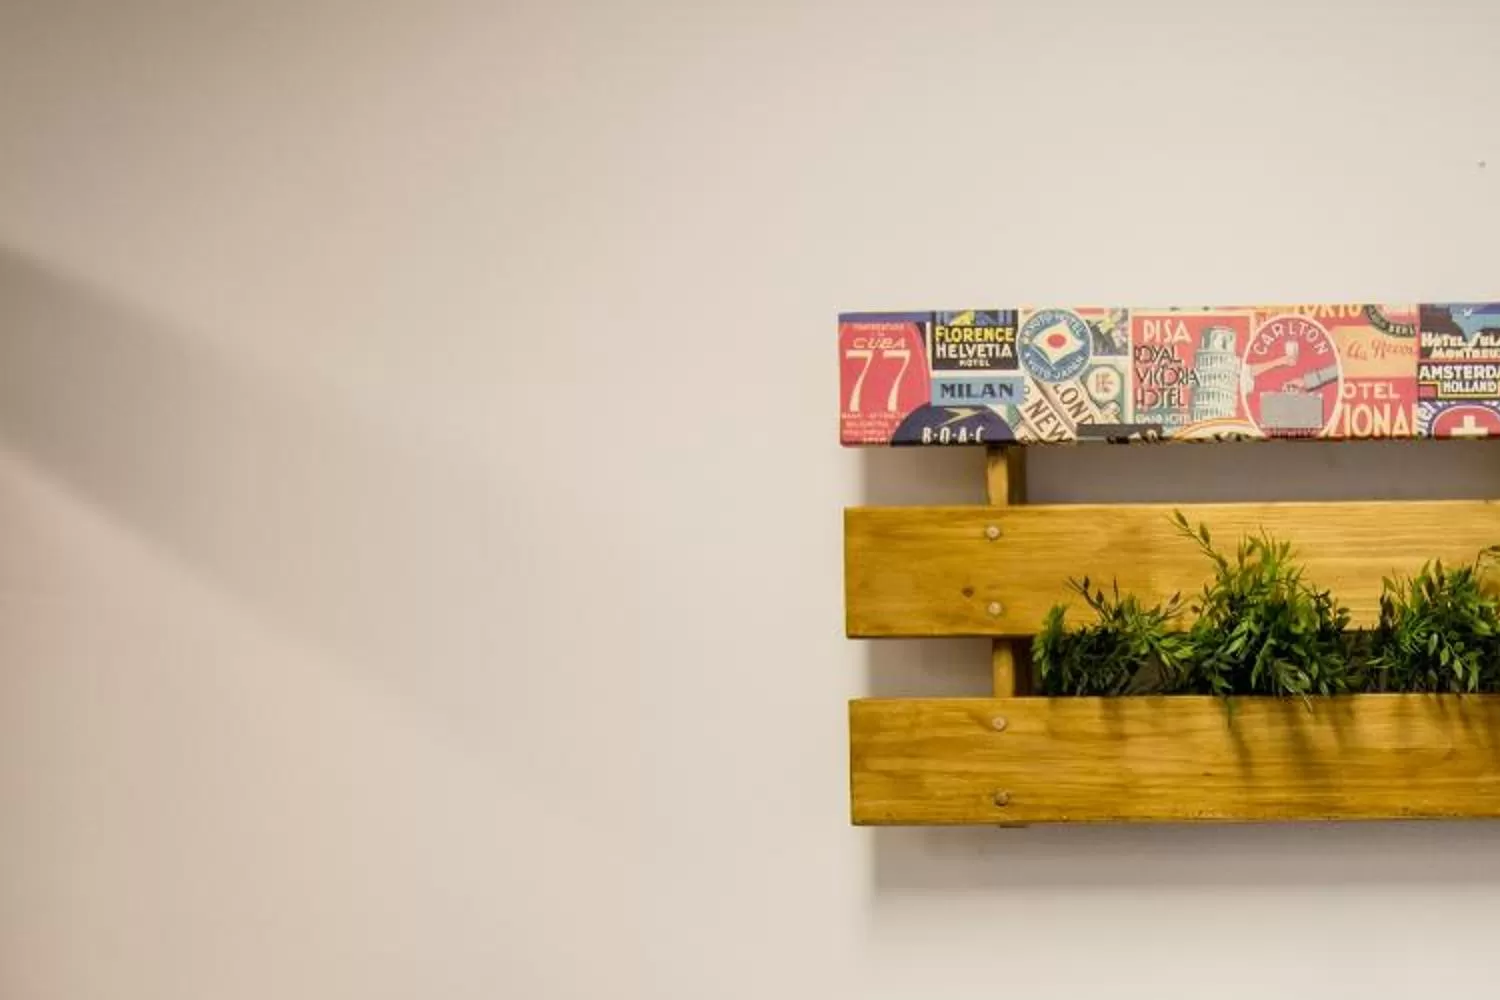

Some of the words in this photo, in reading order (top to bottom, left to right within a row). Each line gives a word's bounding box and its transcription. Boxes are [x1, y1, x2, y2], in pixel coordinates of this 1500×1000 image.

[935, 327, 1014, 343] FLORENCE
[1143, 319, 1192, 344] PISA
[1253, 321, 1328, 355] CARLTON
[852, 336, 907, 350] CUBA
[936, 344, 1013, 359] HELVETIA
[959, 359, 991, 368] HOTEL
[846, 349, 911, 413] 77
[1442, 380, 1497, 393] HOLLAND
[940, 383, 1014, 399] MILAN
